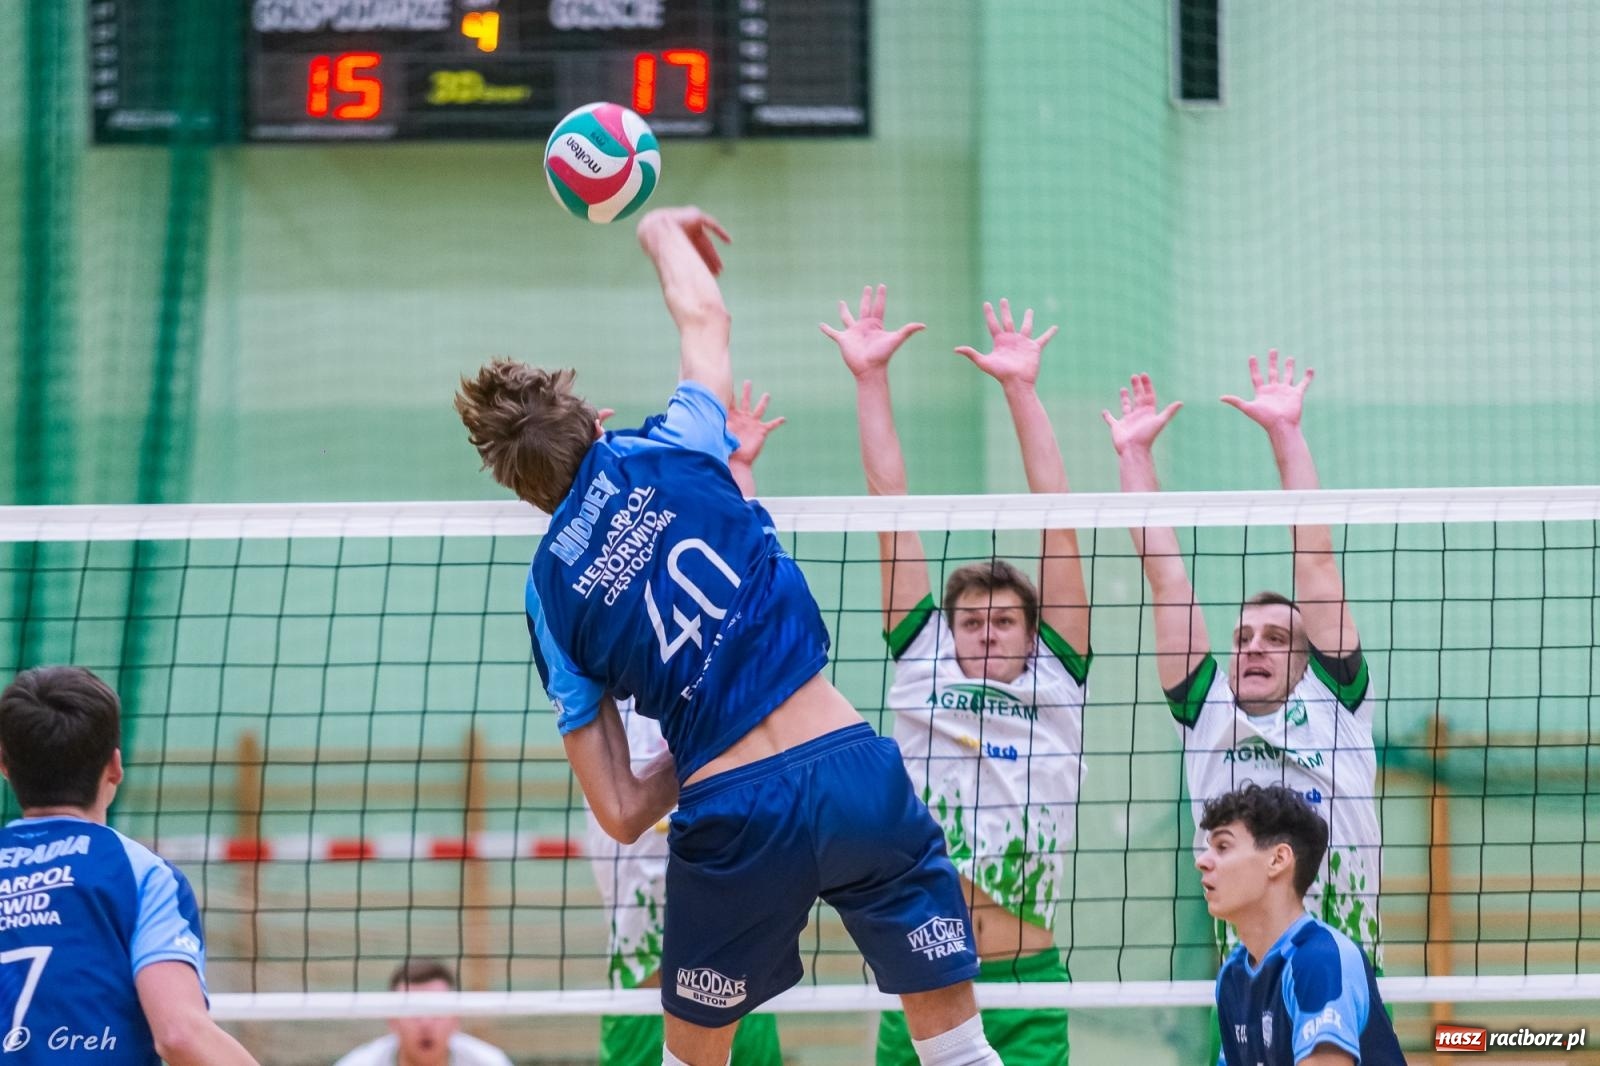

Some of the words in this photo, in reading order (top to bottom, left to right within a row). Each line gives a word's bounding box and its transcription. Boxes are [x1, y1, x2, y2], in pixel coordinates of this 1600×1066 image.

[307, 52, 382, 120] 15
[633, 49, 709, 114] 17
[566, 136, 602, 174] molten
[601, 511, 658, 588] NORWID
[644, 538, 741, 664] 40
[0, 892, 50, 915] WID
[677, 969, 746, 996] WŁODAR
[693, 992, 727, 1006] BETON
